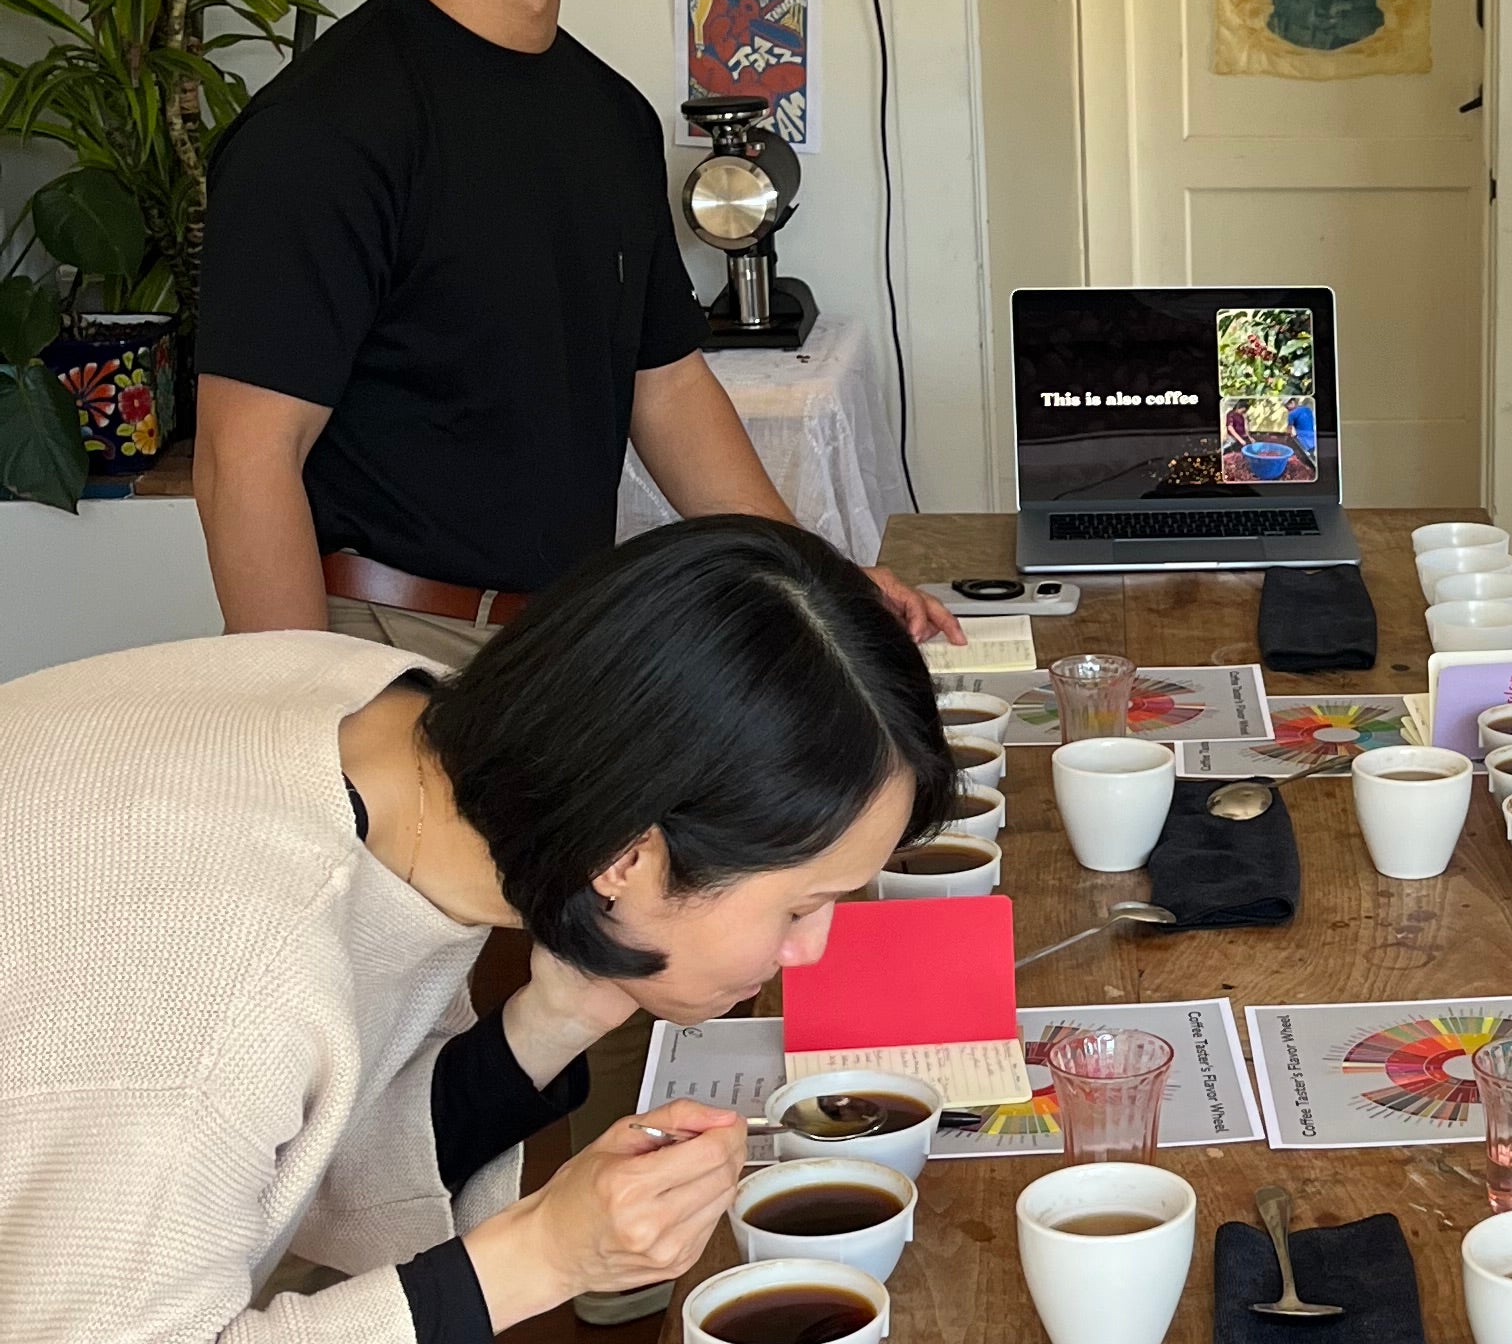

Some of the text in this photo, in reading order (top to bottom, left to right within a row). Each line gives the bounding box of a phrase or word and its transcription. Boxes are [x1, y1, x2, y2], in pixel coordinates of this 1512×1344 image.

[727, 36, 803, 80] JAZZ
[1040, 390, 1199, 407] This is also coffee
[1188, 1010, 1205, 1038] Coffee
[1202, 1074, 1218, 1102] Flavor
[1286, 1043, 1302, 1071] Flavor
[1301, 1108, 1317, 1137] Coffee
